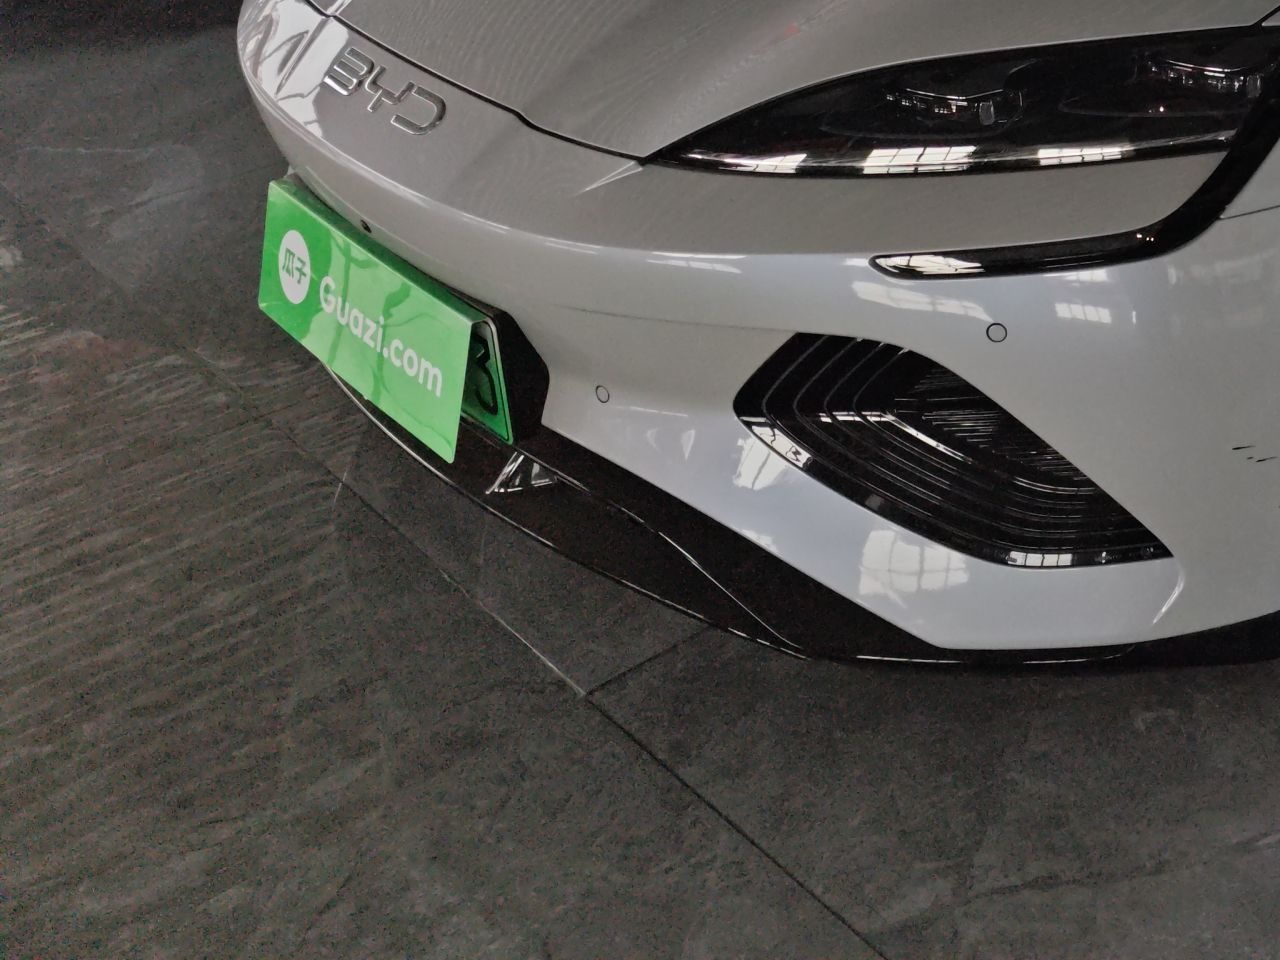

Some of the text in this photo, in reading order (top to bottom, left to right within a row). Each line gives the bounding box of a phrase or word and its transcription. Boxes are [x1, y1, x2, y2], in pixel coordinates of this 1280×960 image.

[324, 46, 447, 136] BYD
[281, 247, 309, 286] 瓜子
[319, 276, 443, 397] Guazi.com
